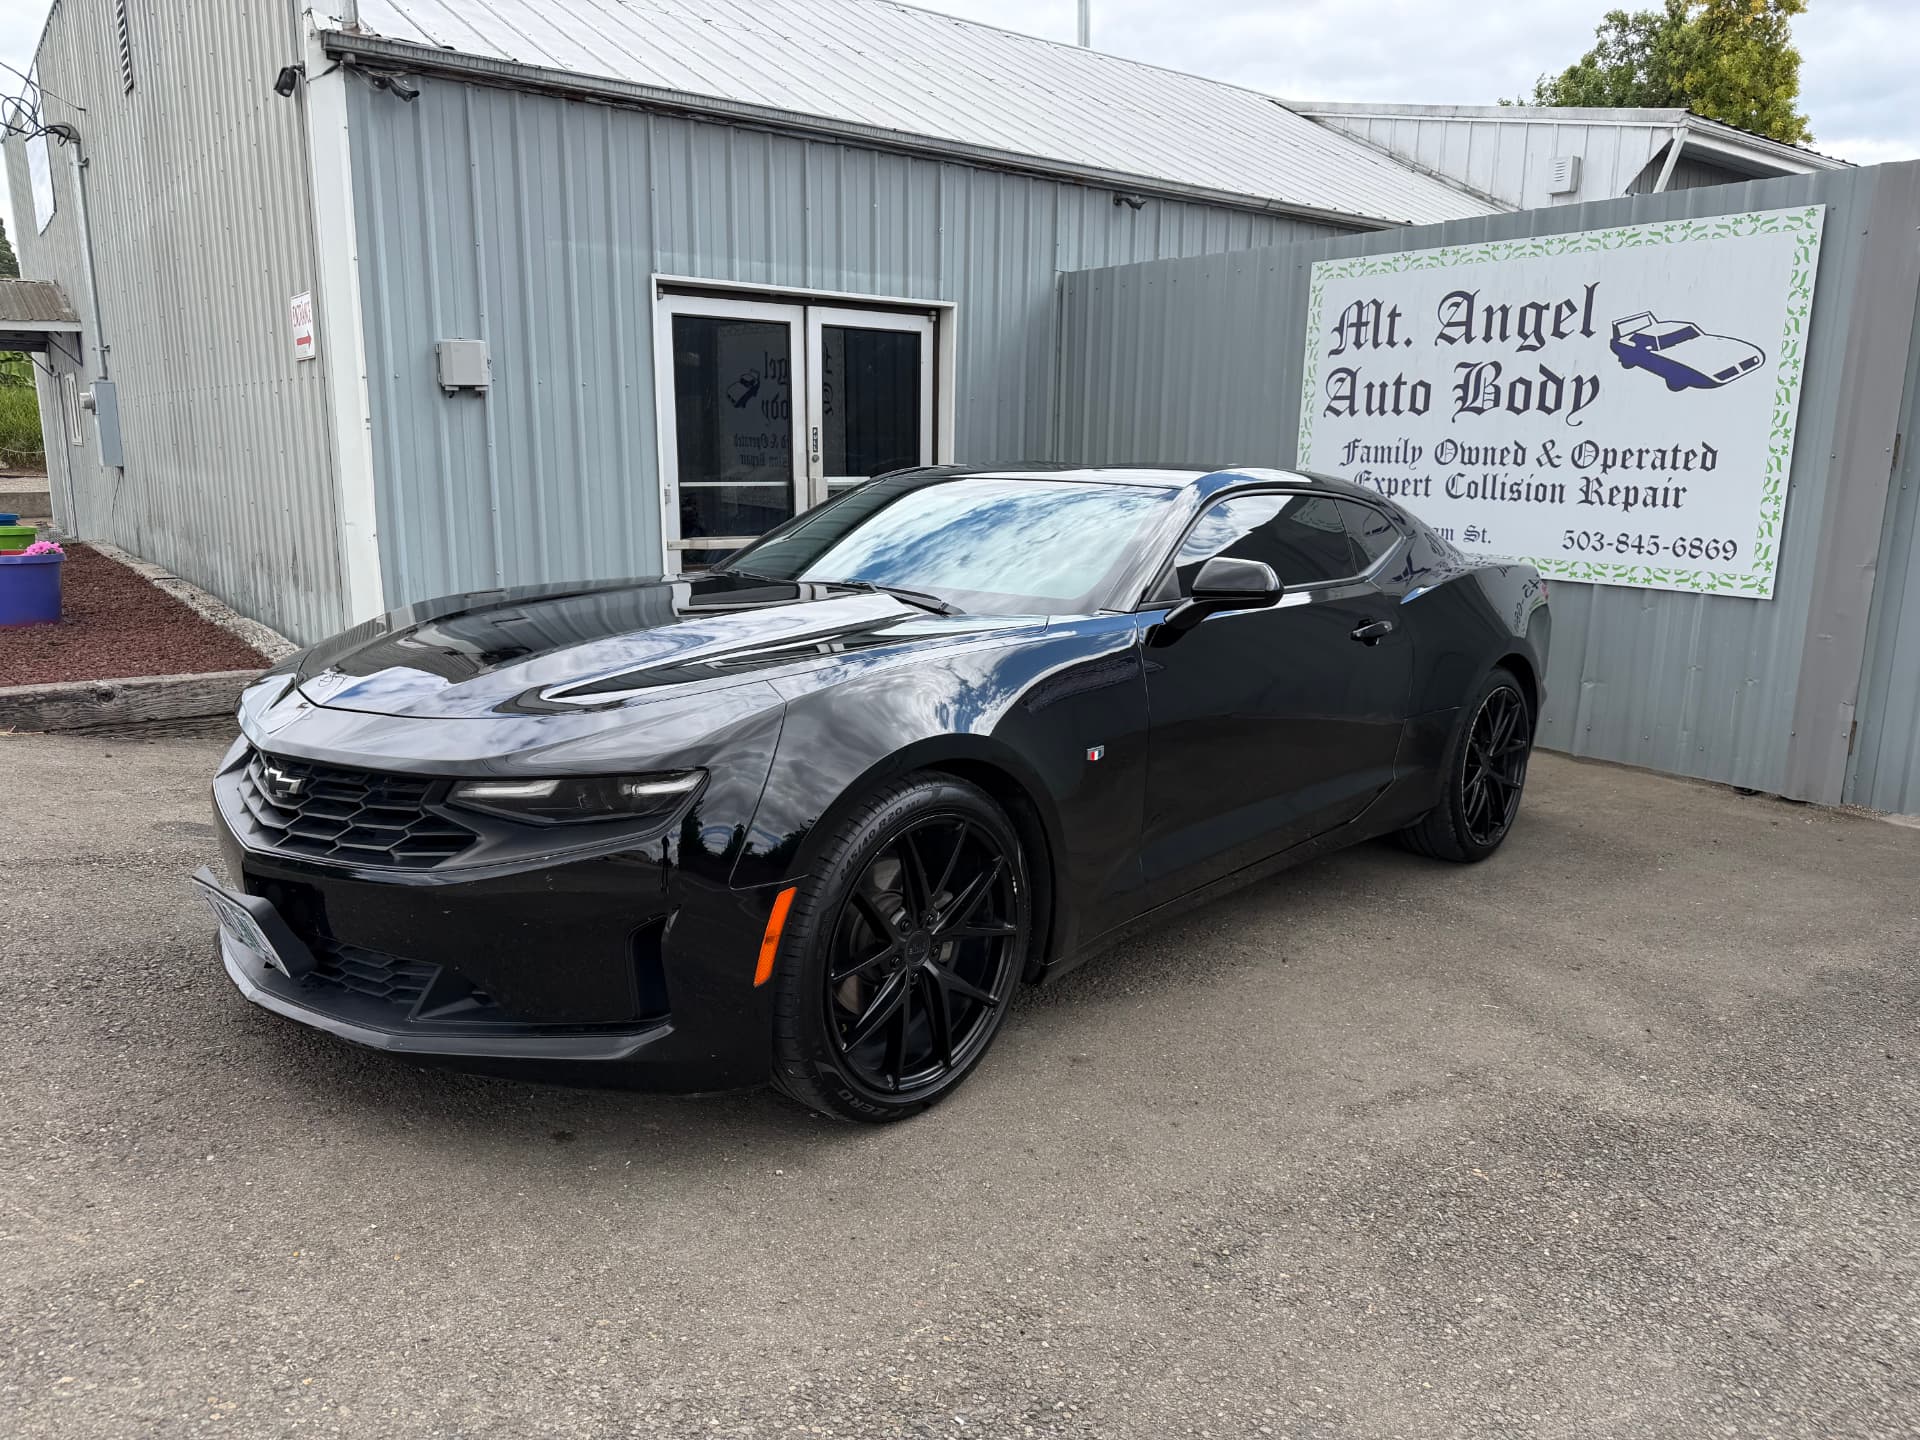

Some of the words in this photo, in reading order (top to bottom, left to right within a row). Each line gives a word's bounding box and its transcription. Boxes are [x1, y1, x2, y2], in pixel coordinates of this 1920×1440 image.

[1328, 298, 1413, 358] Mt.
[1434, 282, 1601, 351] Angel
[1323, 366, 1432, 418] Auto
[1451, 361, 1600, 427] Body
[1339, 437, 1423, 471] Family
[1434, 438, 1527, 468] Owned
[1535, 439, 1563, 469] &
[1570, 439, 1719, 476] Operated
[1445, 472, 1565, 505] Collision
[1576, 476, 1688, 513] Repair
[1463, 524, 1492, 544] St.
[1562, 529, 1738, 562] 503-845-6869
